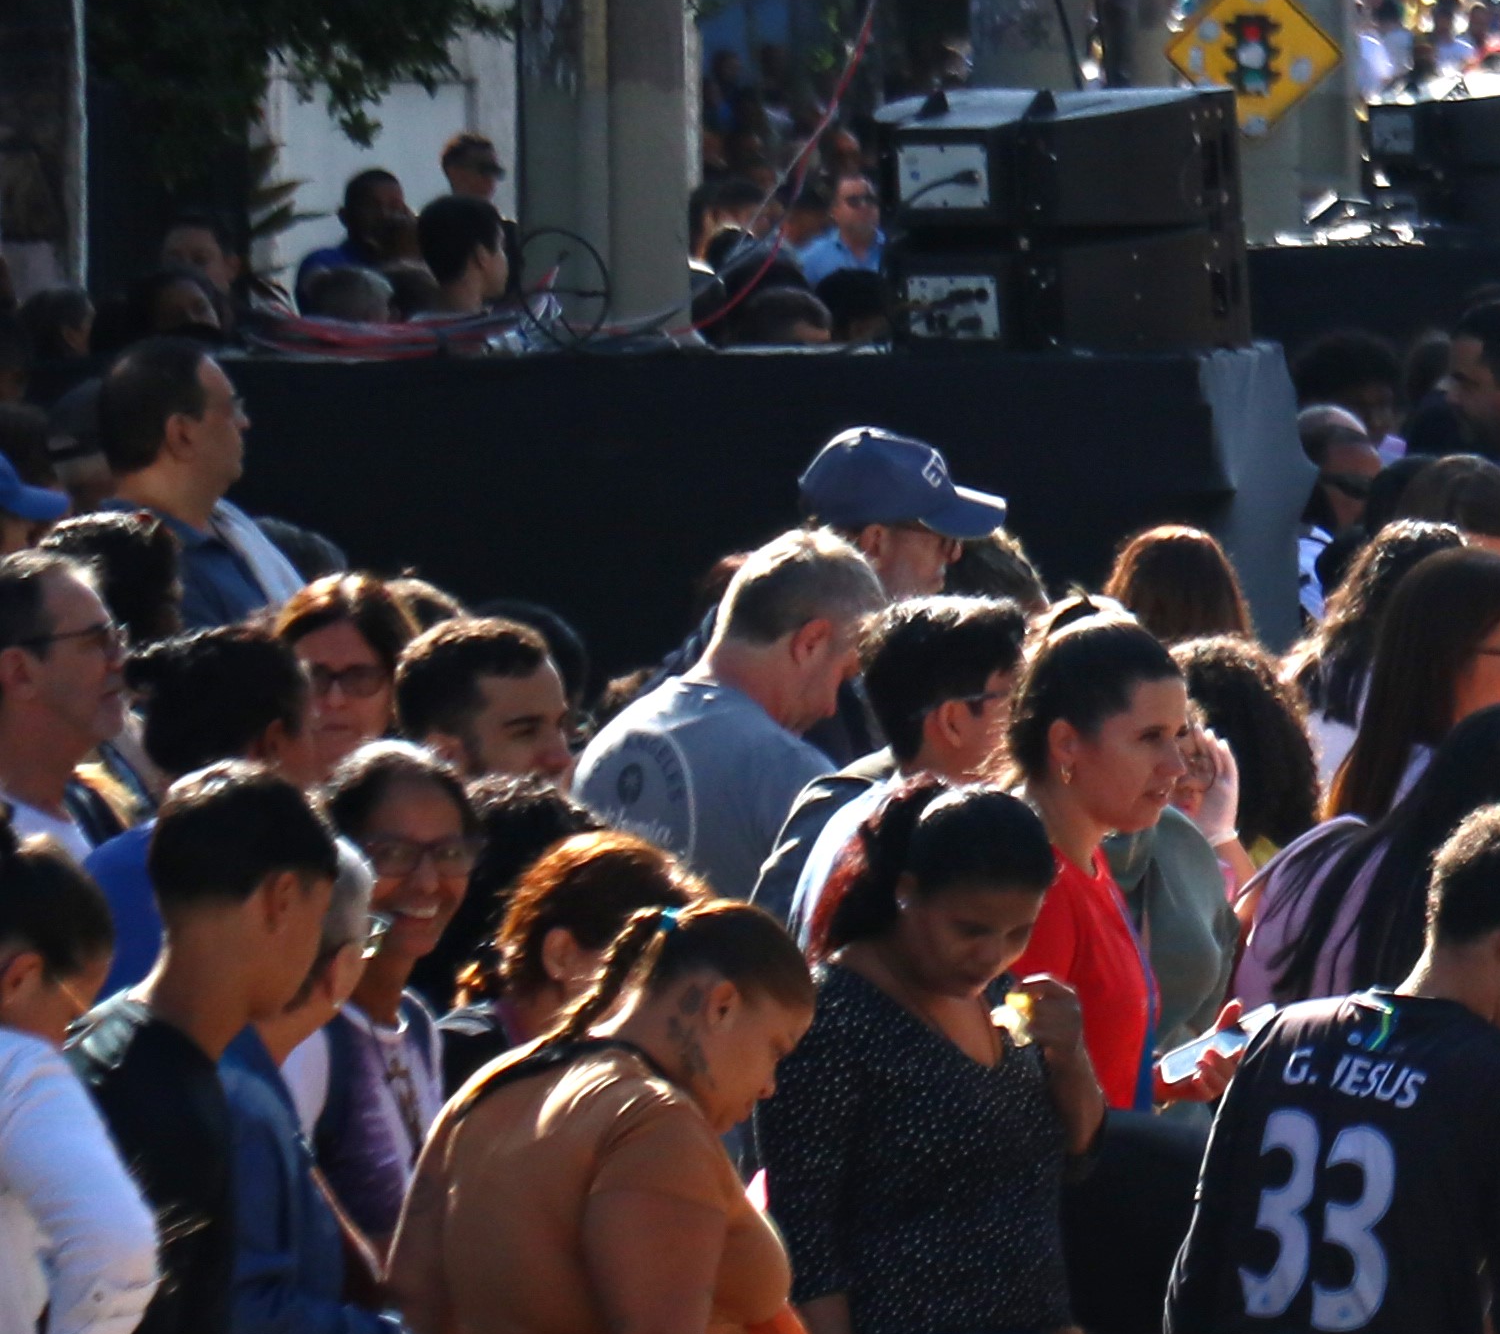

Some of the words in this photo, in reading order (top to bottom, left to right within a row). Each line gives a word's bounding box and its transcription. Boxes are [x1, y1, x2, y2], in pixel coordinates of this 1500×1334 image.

[1282, 1047, 1318, 1085] G.
[1330, 1055, 1427, 1109] JESUS
[1239, 1107, 1395, 1332] 33
